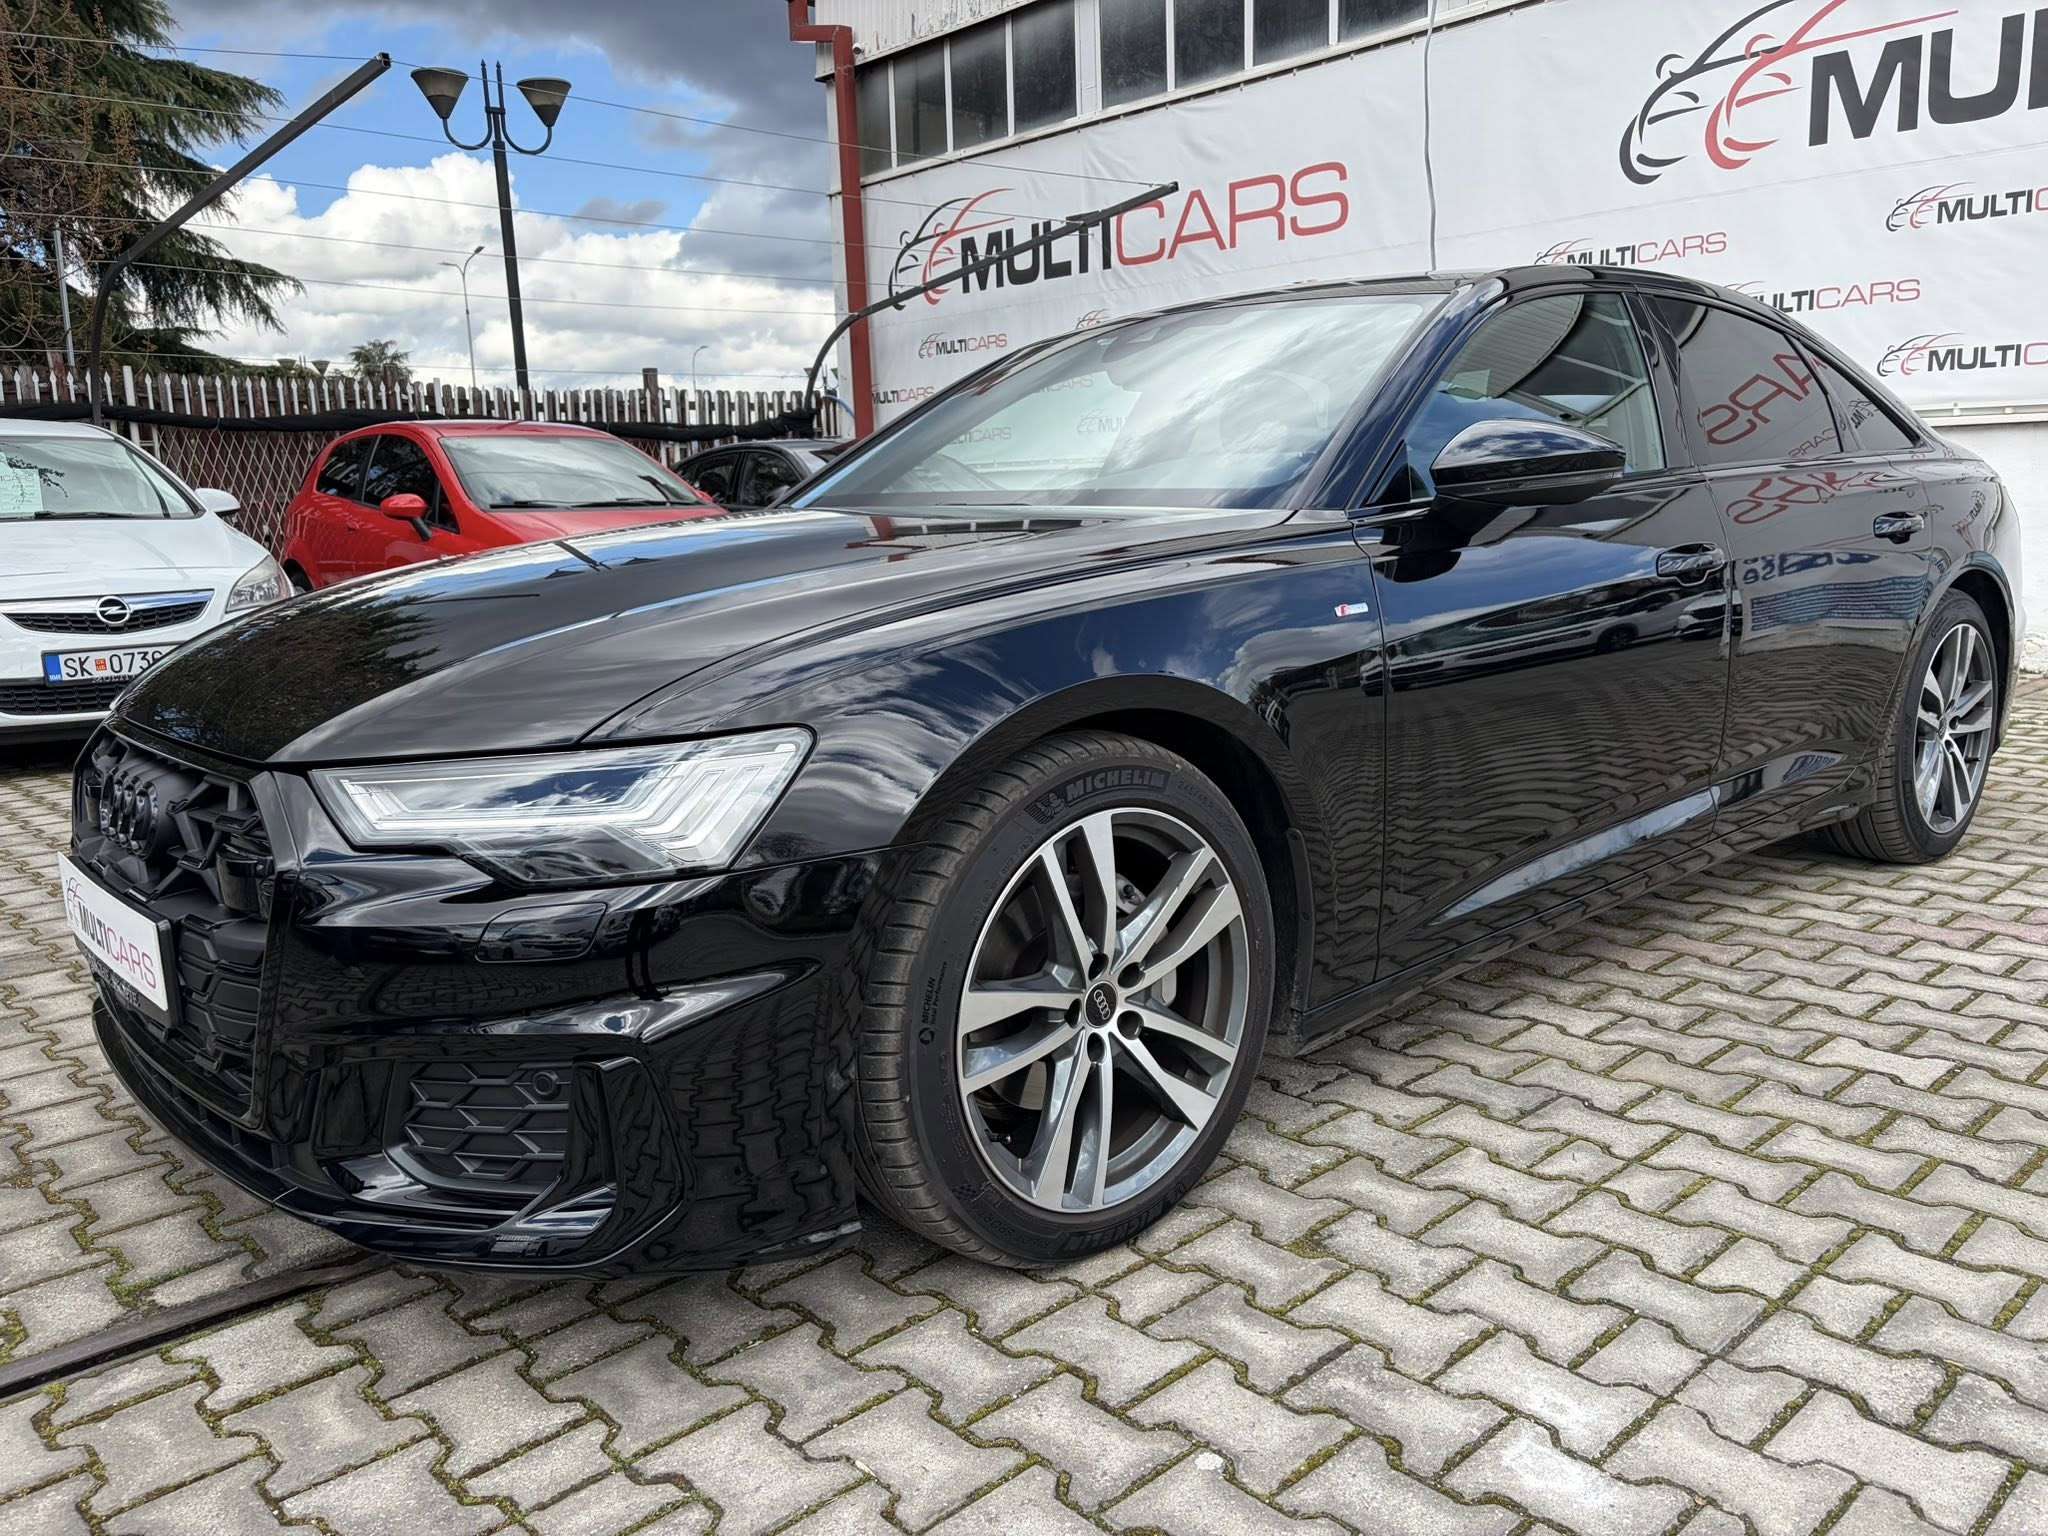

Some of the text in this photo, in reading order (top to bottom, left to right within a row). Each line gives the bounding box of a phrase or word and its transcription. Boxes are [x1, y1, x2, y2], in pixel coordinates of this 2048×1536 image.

[936, 333, 1008, 355] MULTICARS
[64, 656, 92, 677] SK
[1066, 769, 1166, 801] MICHELIN
[78, 901, 156, 989] MULTICARS
